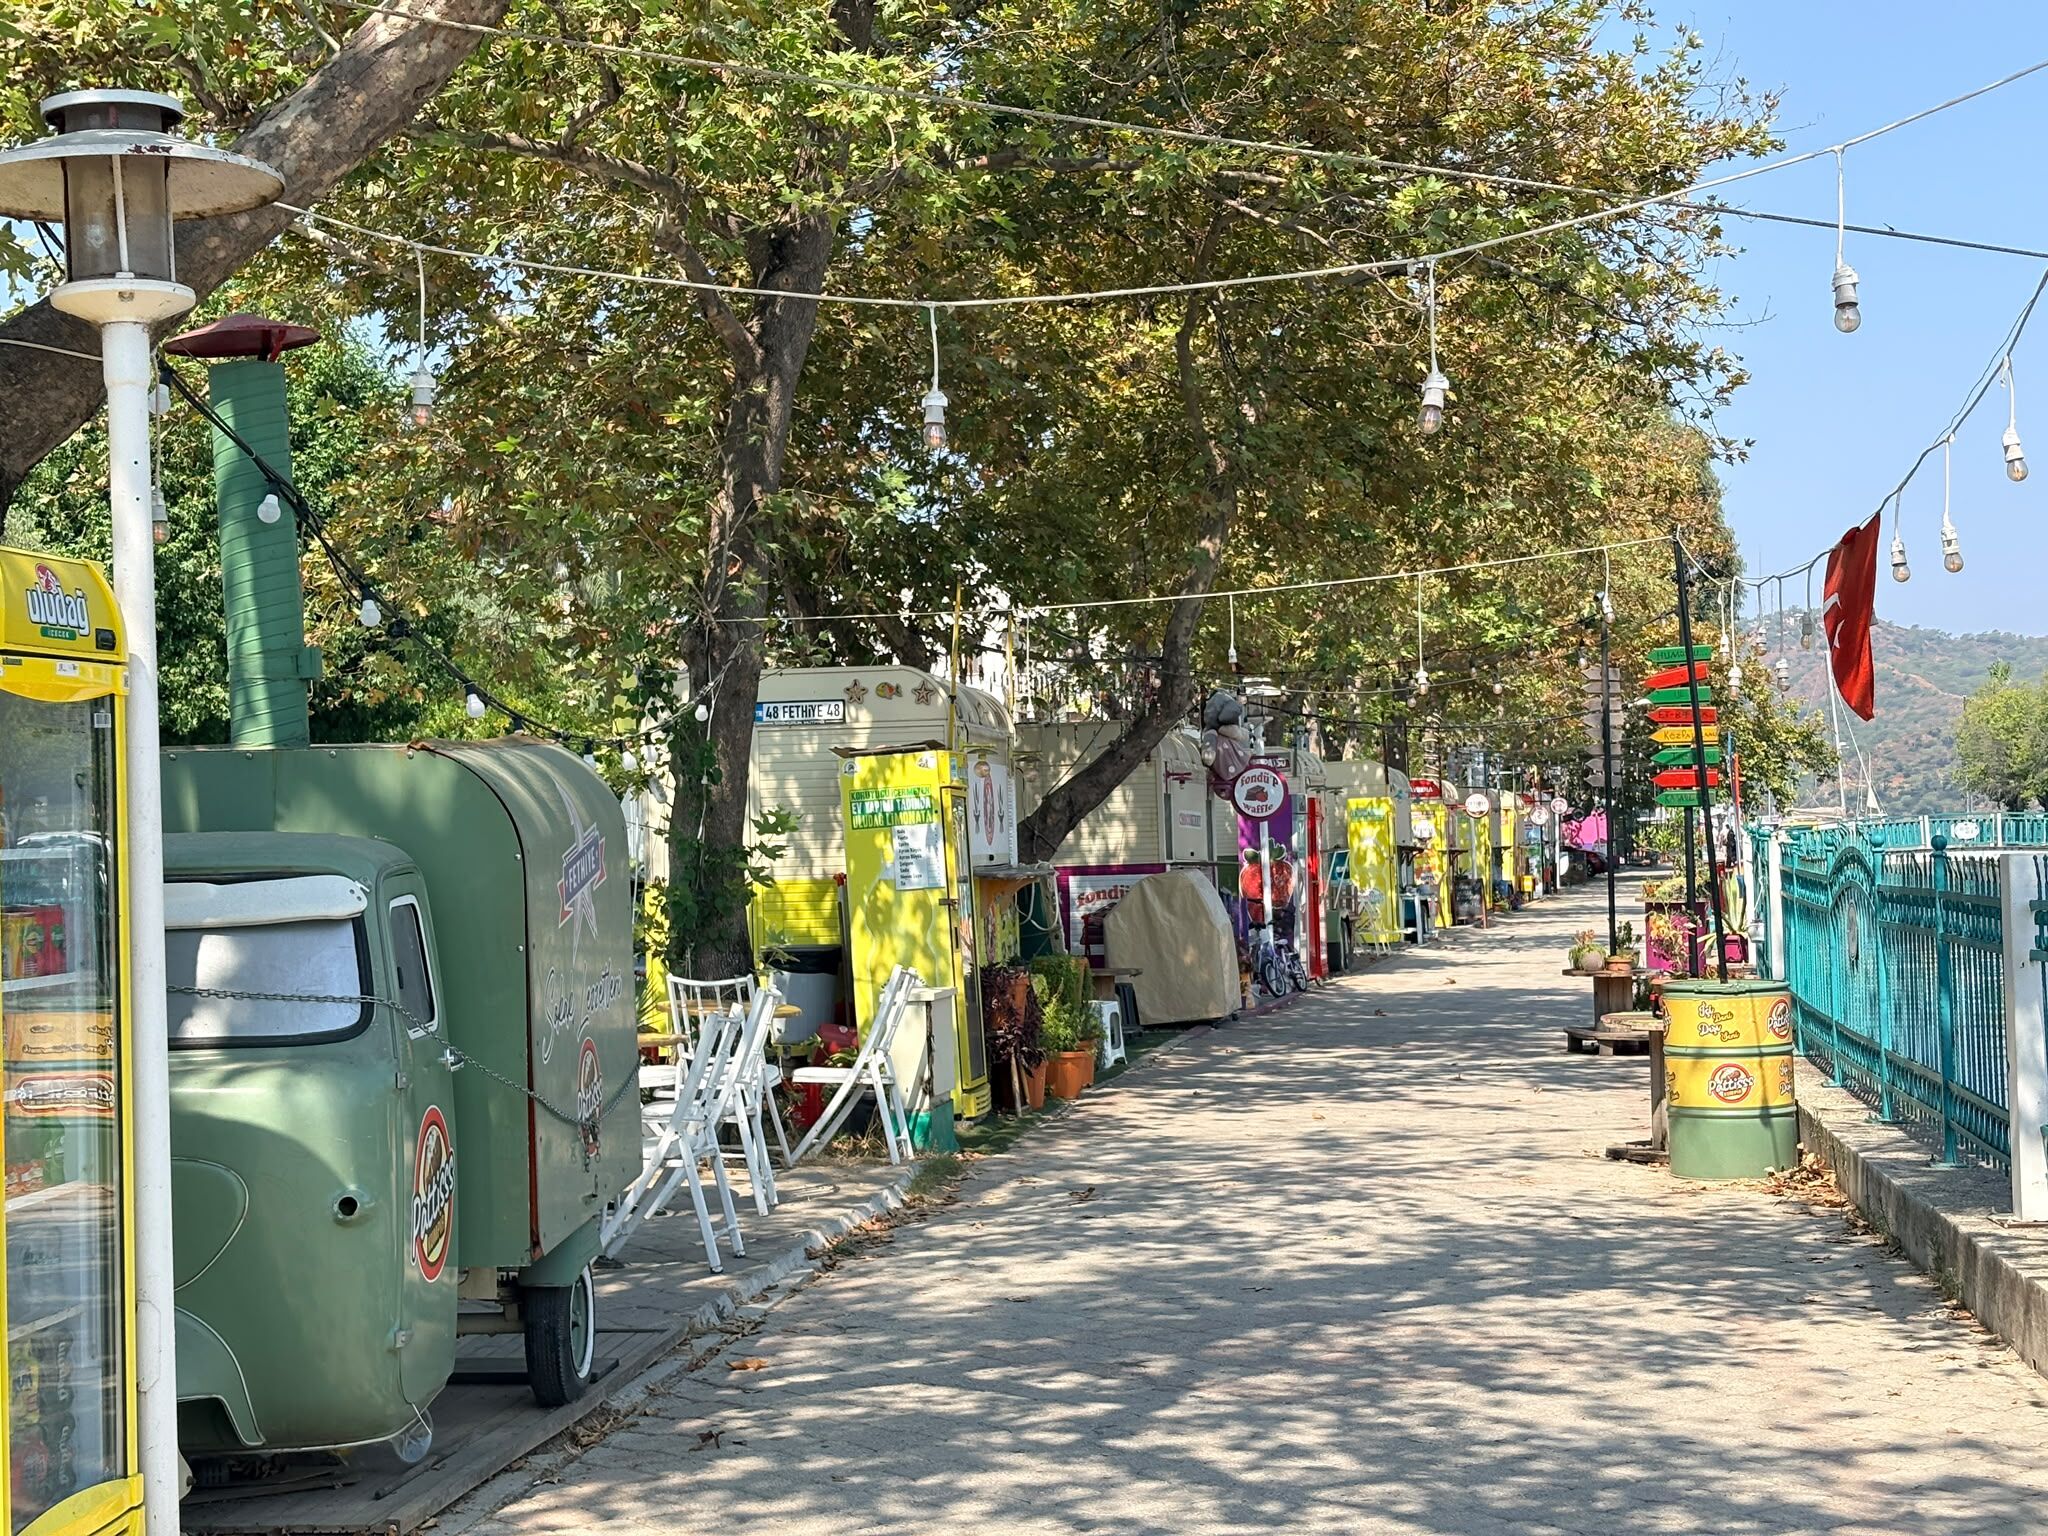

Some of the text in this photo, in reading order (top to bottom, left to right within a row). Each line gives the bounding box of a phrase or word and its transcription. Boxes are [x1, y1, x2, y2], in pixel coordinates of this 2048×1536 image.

[26, 582, 90, 637] uludağ
[765, 703, 840, 719] 48 FETHİYE 48
[851, 801, 862, 815] EV
[1242, 802, 1274, 814] waffle
